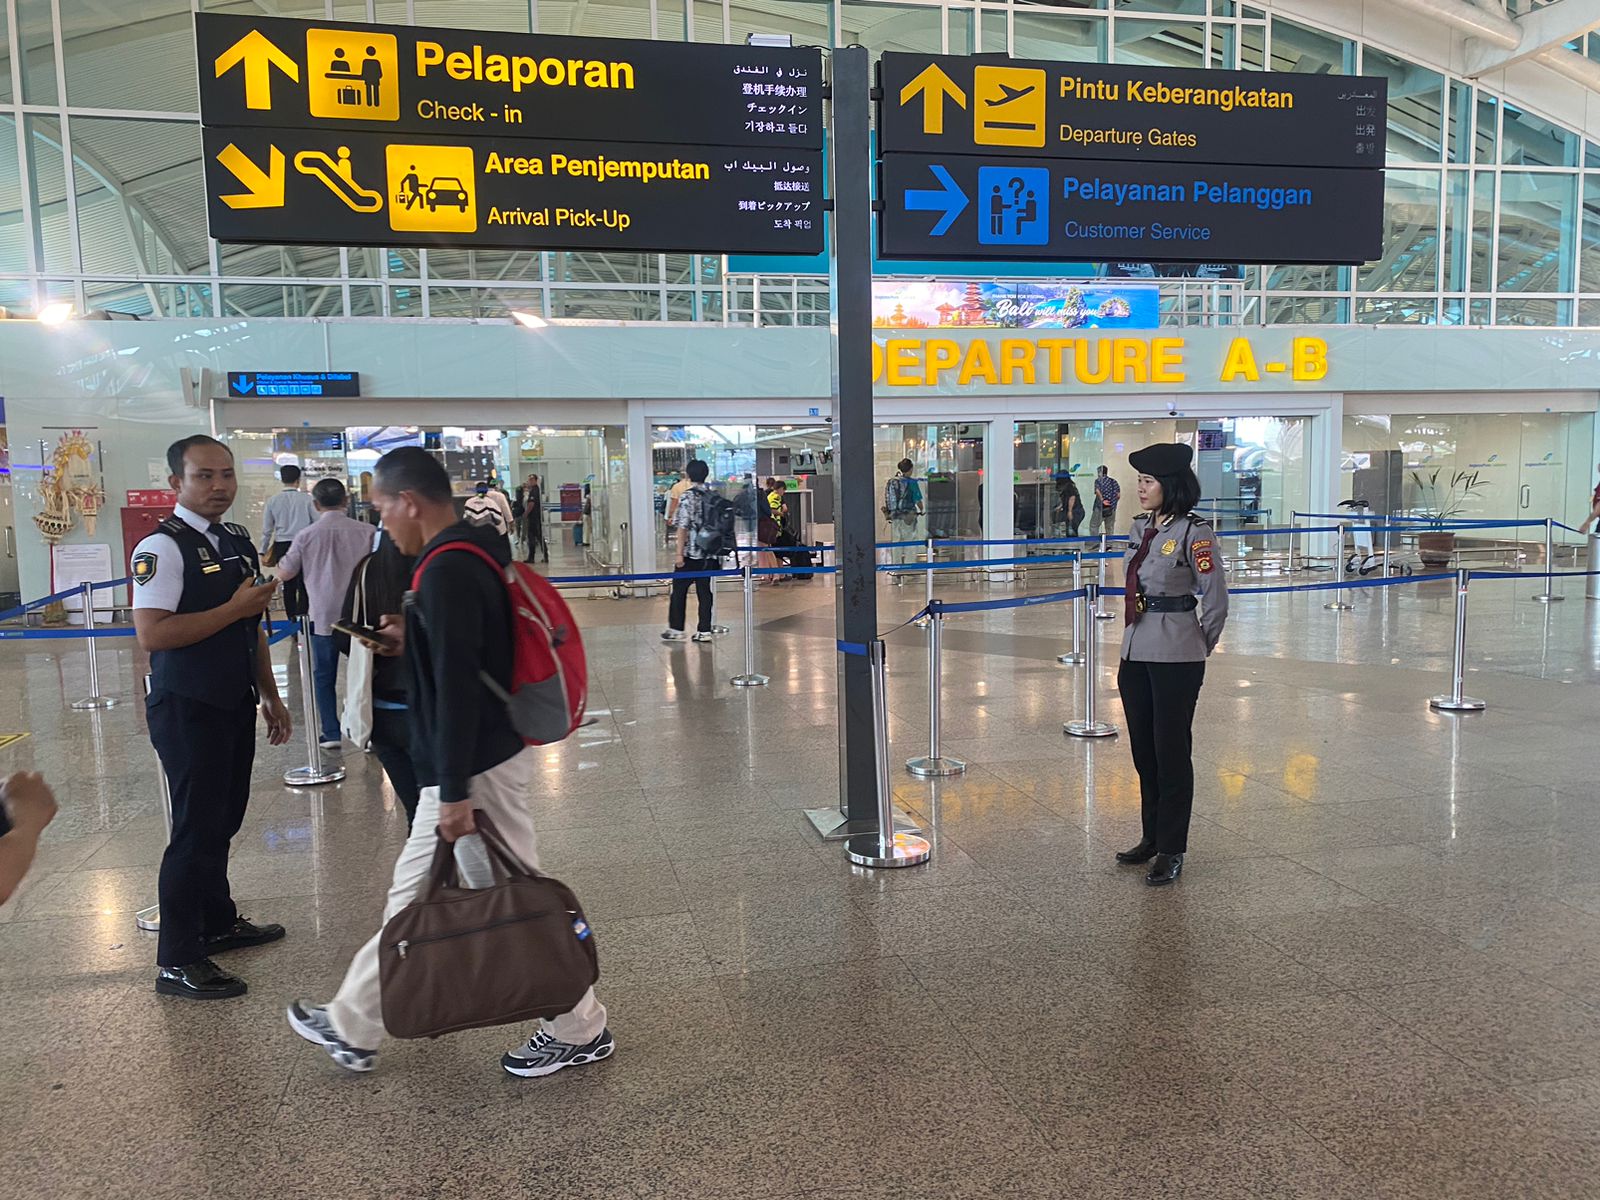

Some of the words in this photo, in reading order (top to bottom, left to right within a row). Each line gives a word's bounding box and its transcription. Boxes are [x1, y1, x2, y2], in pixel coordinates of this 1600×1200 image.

[416, 41, 635, 93] Pelaporan
[733, 65, 769, 74] الفندق
[789, 68, 807, 78] نزل
[742, 83, 808, 98] 登机手续办理
[1060, 76, 1119, 101] Pintu
[1127, 80, 1294, 111] Keberangkatan
[417, 99, 485, 122] Check
[504, 104, 523, 124] in
[747, 102, 808, 115] チェックイン
[745, 120, 786, 133] 기장하고
[1059, 124, 1143, 146] Departure
[1147, 128, 1198, 147] Gates
[484, 152, 544, 175] Area
[551, 154, 710, 183] Penjemputan
[742, 160, 777, 173] البيك
[783, 161, 811, 174] وصول
[1063, 177, 1185, 206] Pelayanan
[1193, 181, 1312, 210] Pelanggan
[487, 207, 549, 226] Arrival
[555, 208, 632, 232] Pick-Up
[1065, 220, 1146, 239] Customer
[1151, 223, 1211, 240] Service
[995, 299, 1034, 318] Bali
[1035, 305, 1056, 316] will
[872, 337, 1185, 386] EPARTURE
